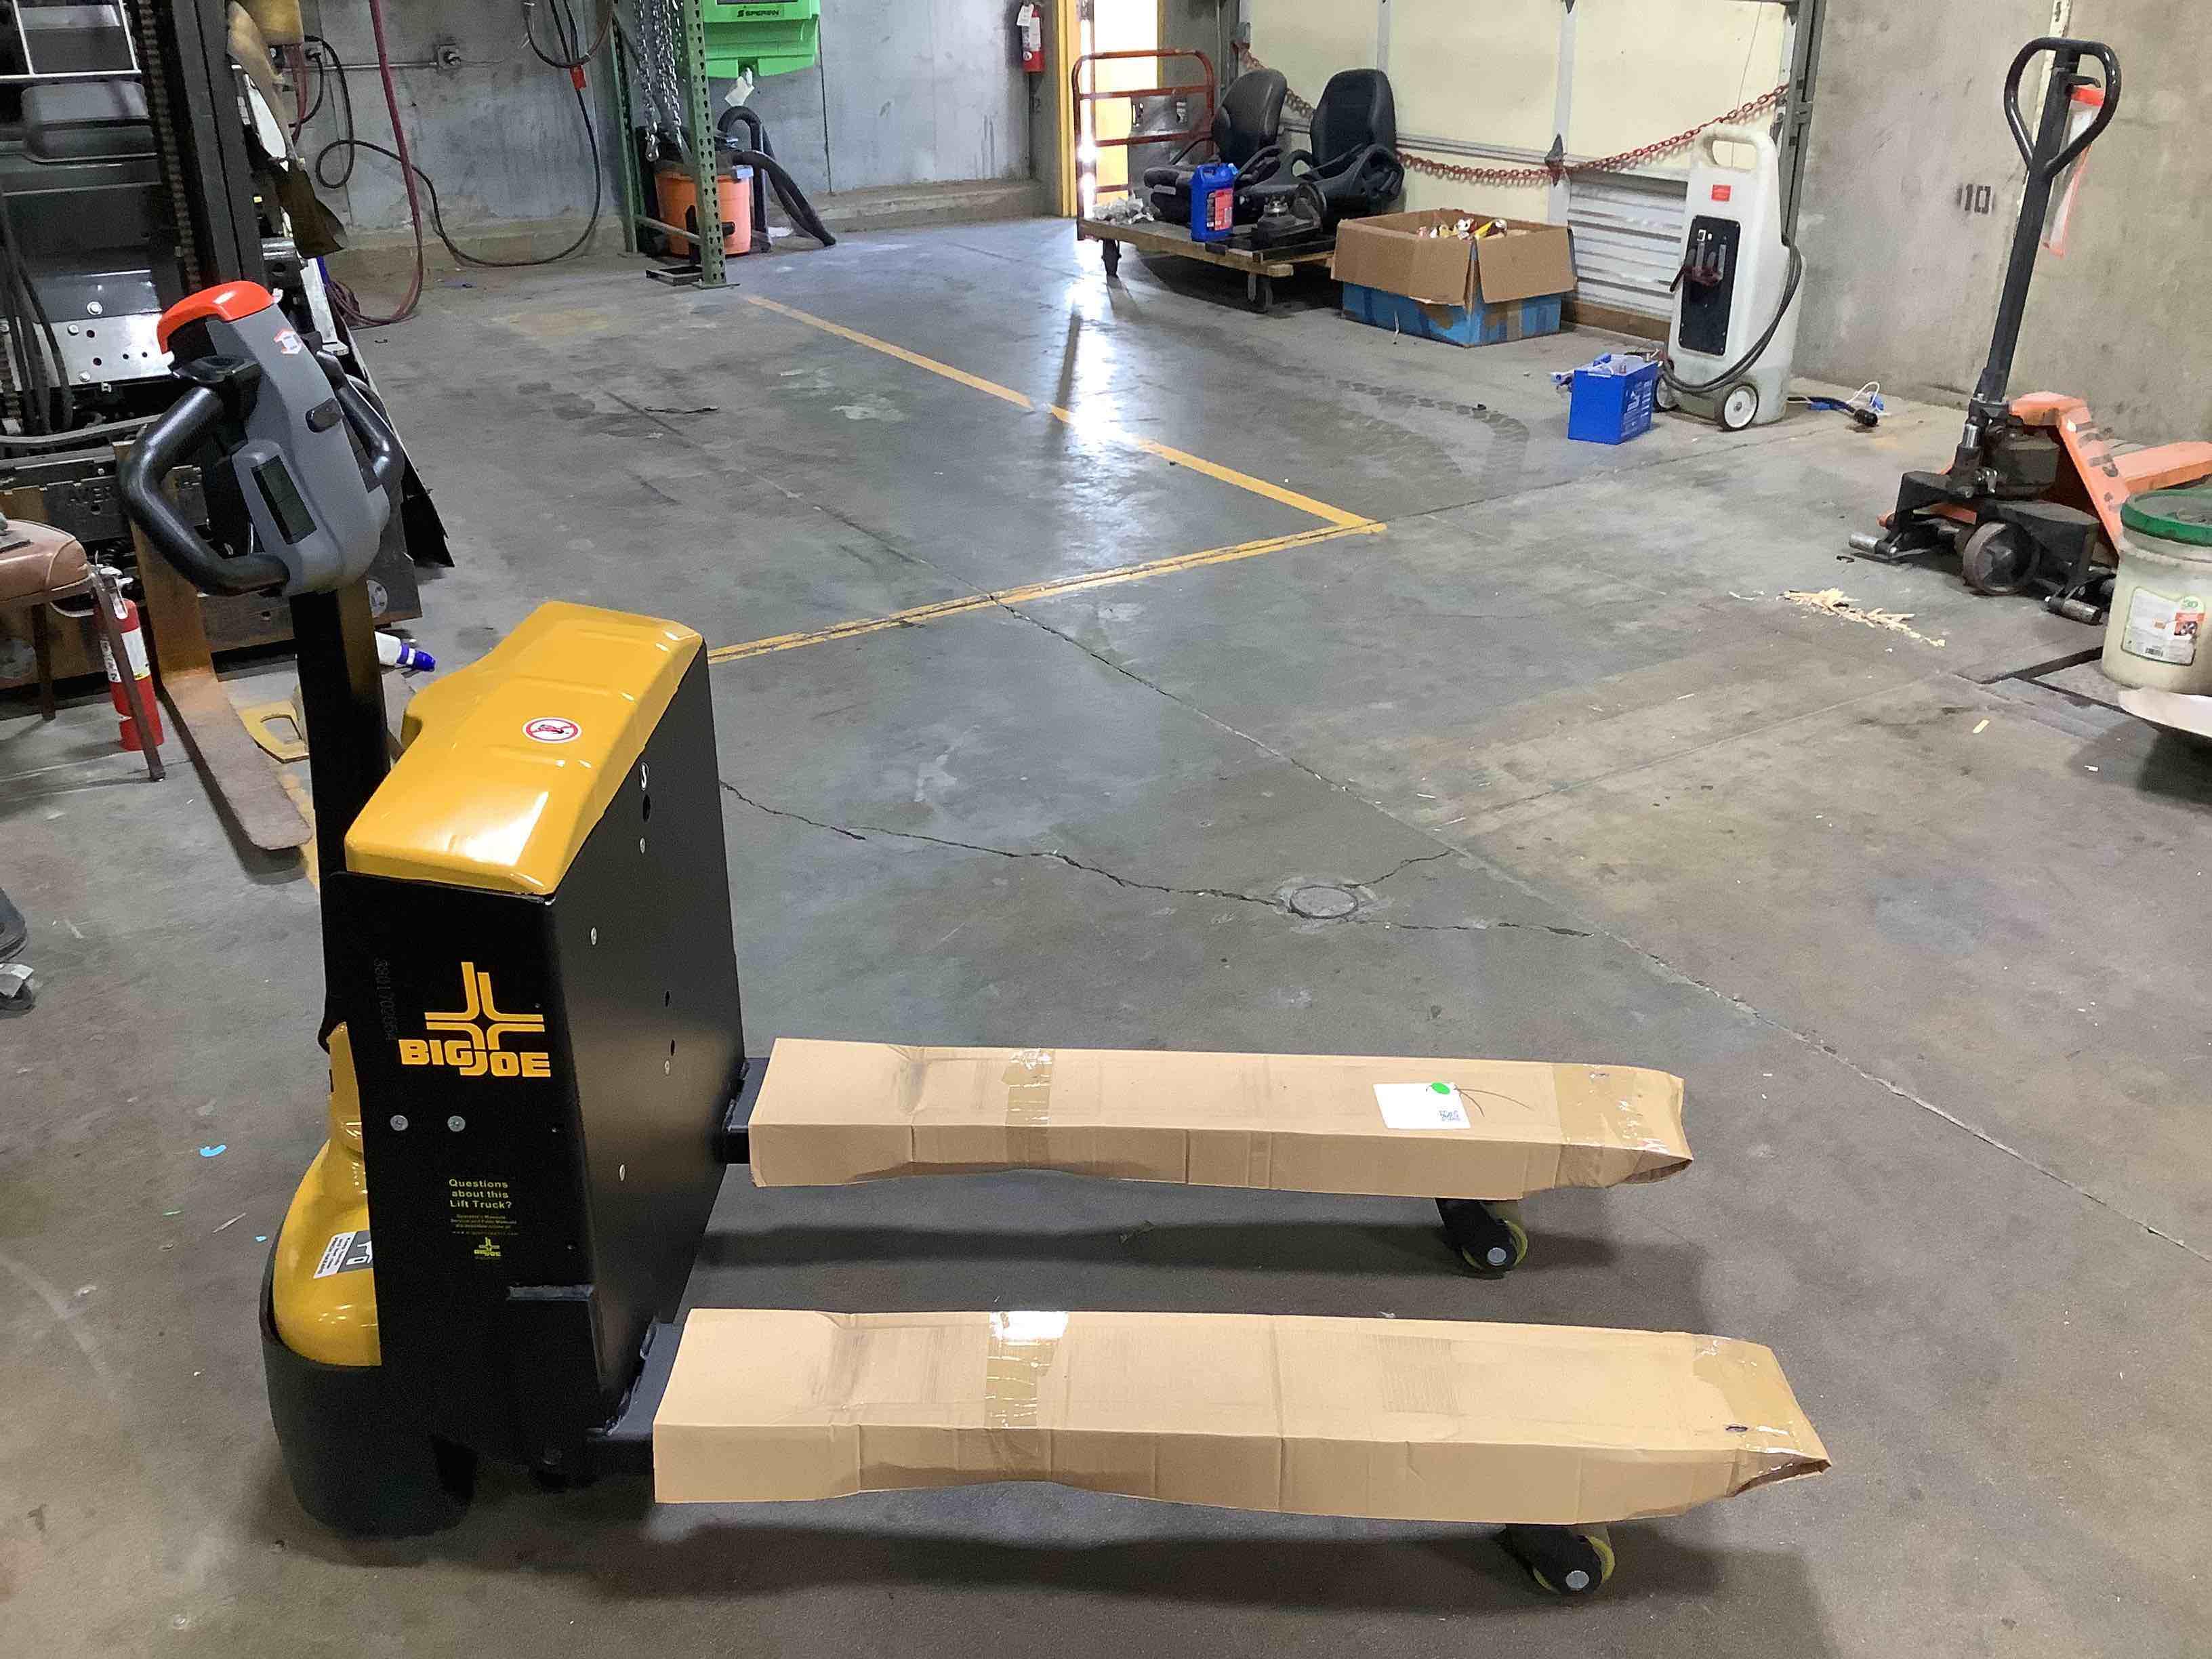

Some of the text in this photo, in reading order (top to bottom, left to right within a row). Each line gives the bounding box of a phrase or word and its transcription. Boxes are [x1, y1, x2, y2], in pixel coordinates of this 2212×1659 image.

[449, 1179, 509, 1188] Questions
[451, 1189, 509, 1199] about this
[450, 1200, 512, 1209] Lift Truck?
